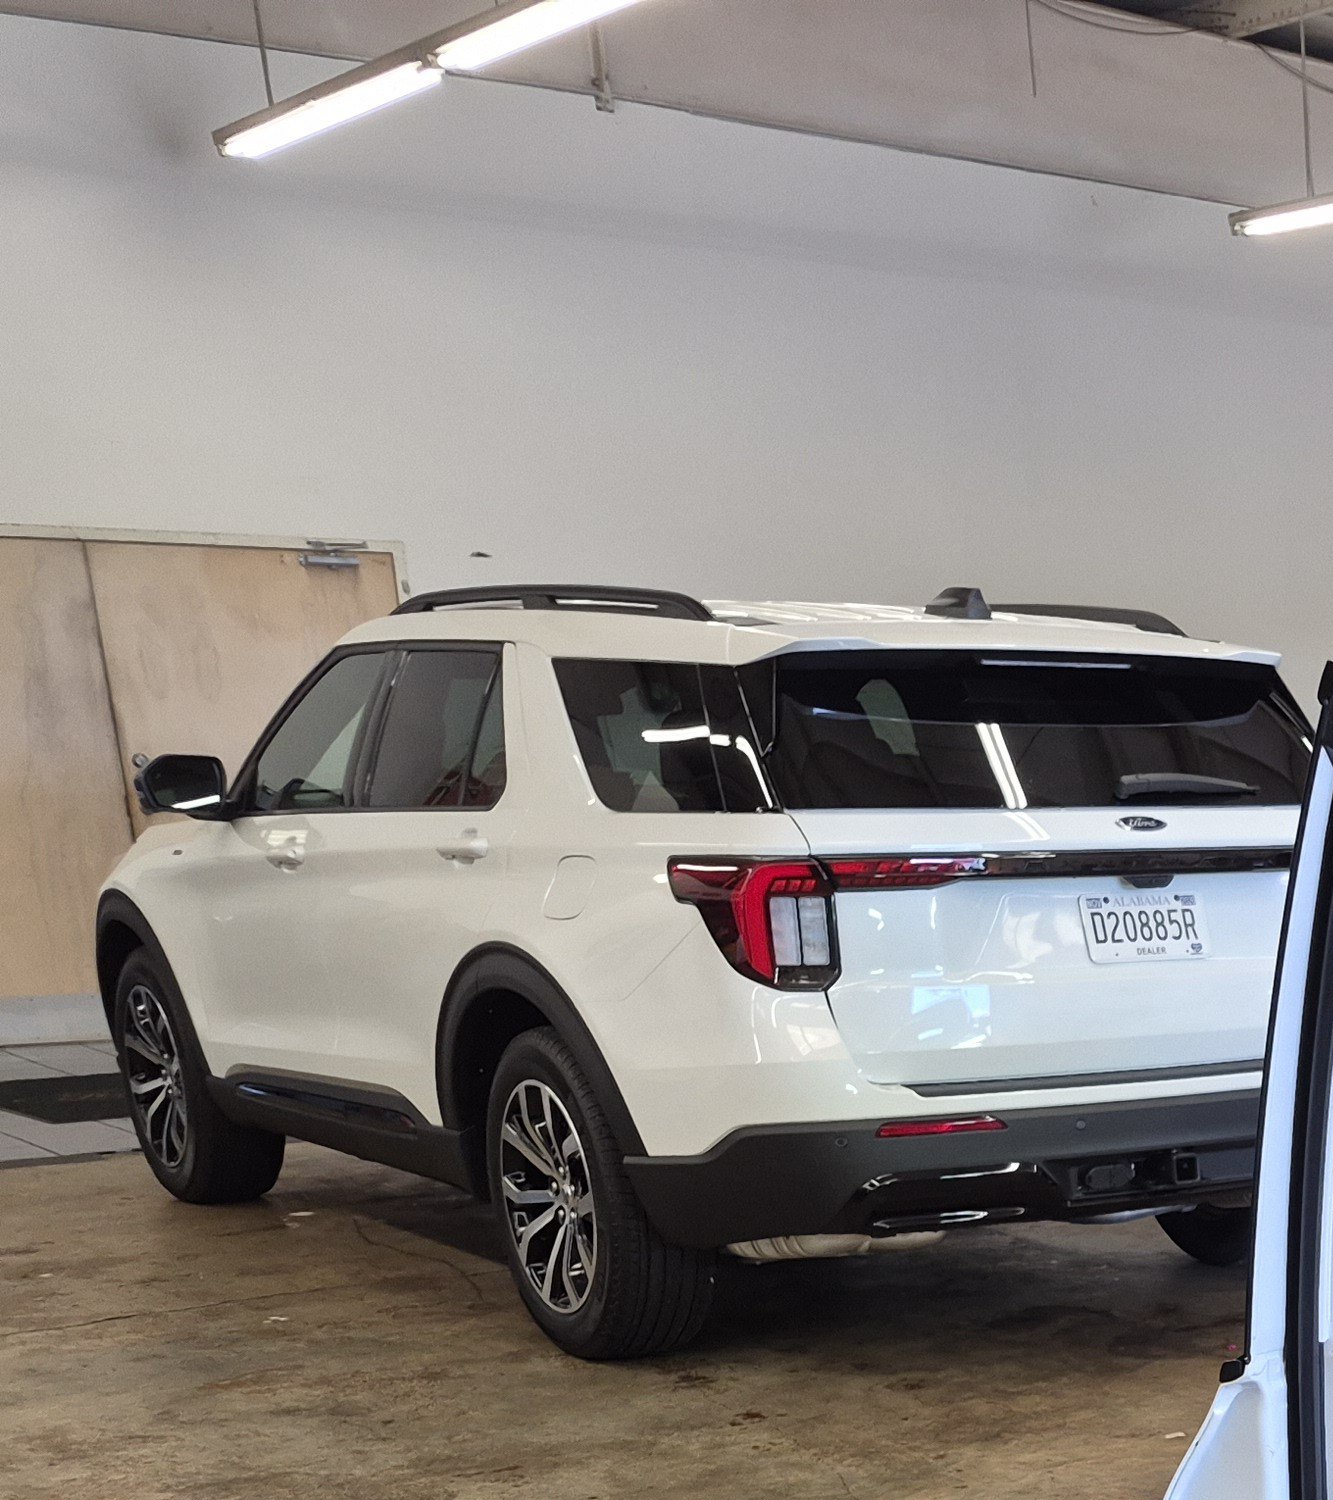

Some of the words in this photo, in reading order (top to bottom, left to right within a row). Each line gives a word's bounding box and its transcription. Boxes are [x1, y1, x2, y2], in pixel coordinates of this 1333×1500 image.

[1112, 896, 1171, 907] ALABAMA
[1090, 908, 1199, 944] D20885R
[1137, 947, 1167, 956] DEALER
